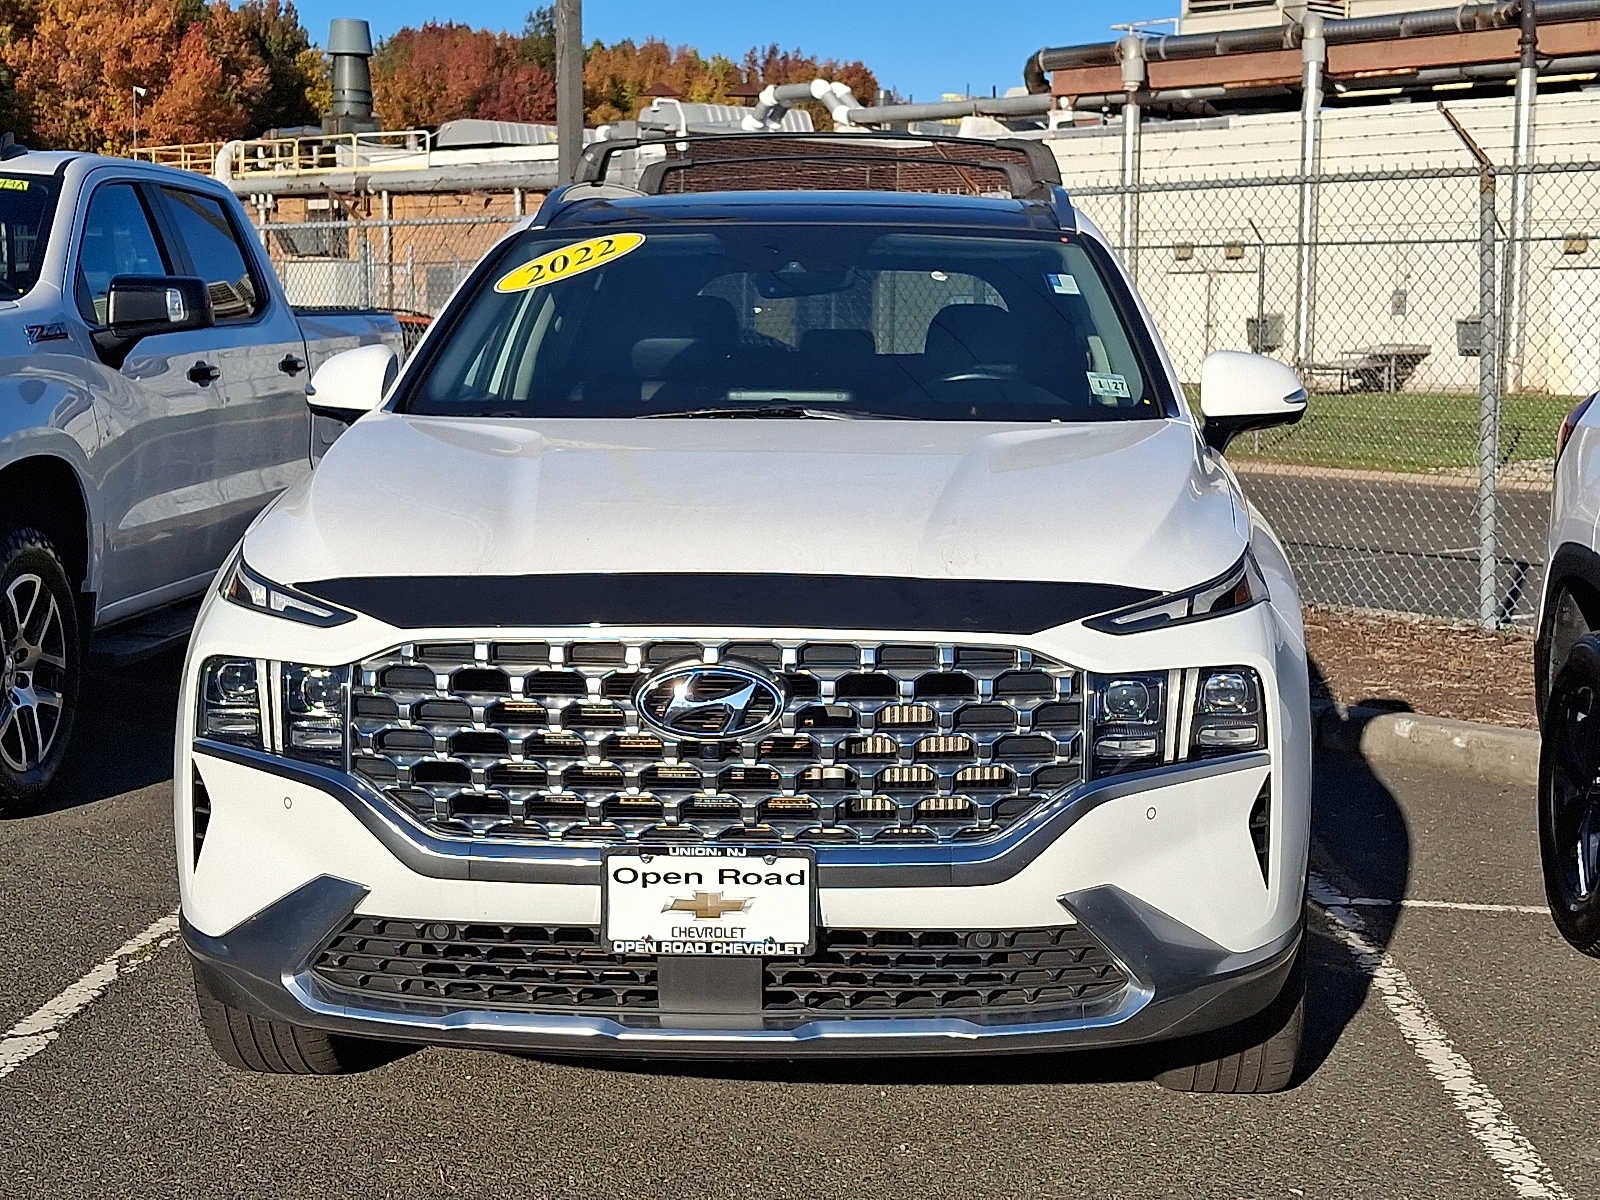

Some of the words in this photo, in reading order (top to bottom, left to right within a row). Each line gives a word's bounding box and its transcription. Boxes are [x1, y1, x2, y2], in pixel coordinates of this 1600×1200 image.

[526, 239, 617, 285] 2022
[1112, 381, 1125, 390] 27
[726, 847, 747, 857] NJ
[613, 867, 703, 888] Open
[718, 868, 805, 886] Road
[671, 926, 747, 938] CHEVROLET
[613, 941, 657, 953] OPEN
[661, 942, 707, 954] ROAD
[711, 942, 804, 955] CHEVROLET
